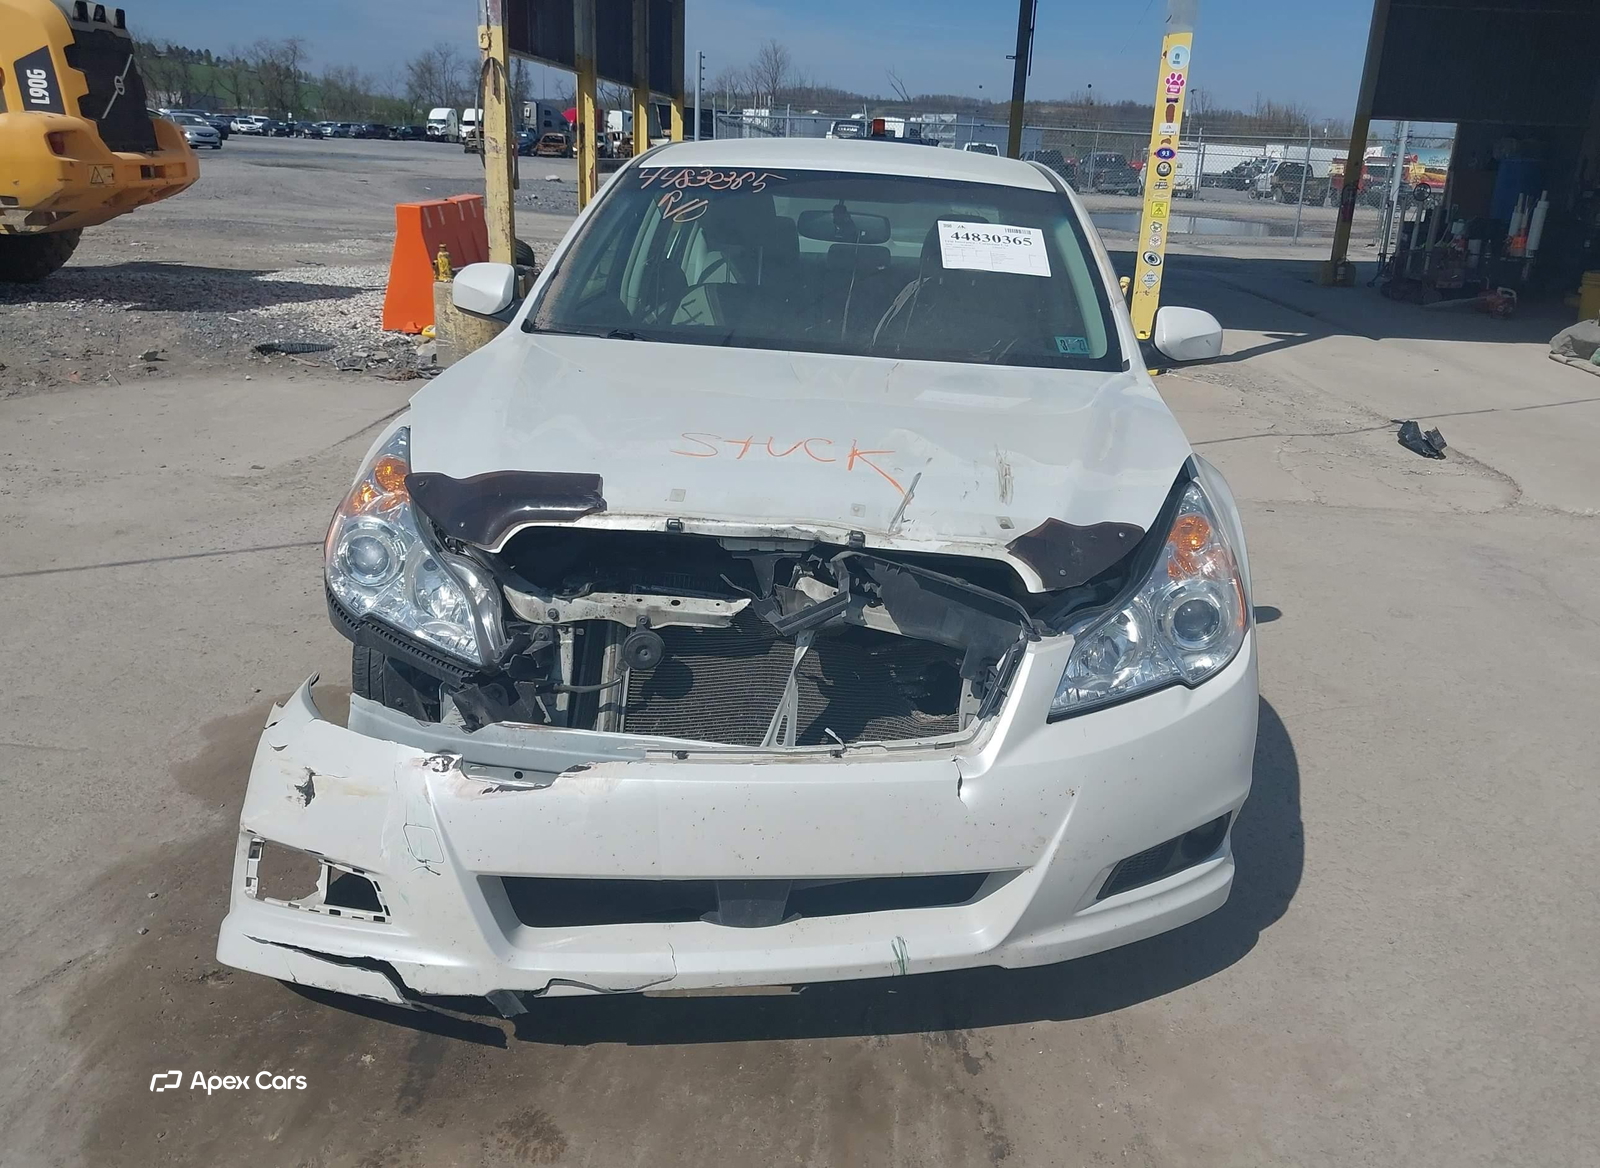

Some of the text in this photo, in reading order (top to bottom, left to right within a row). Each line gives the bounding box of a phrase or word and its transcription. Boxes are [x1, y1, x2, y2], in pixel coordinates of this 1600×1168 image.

[26, 69, 50, 104] L90G
[950, 231, 1033, 247] 44830365
[670, 432, 909, 500] STUCK
